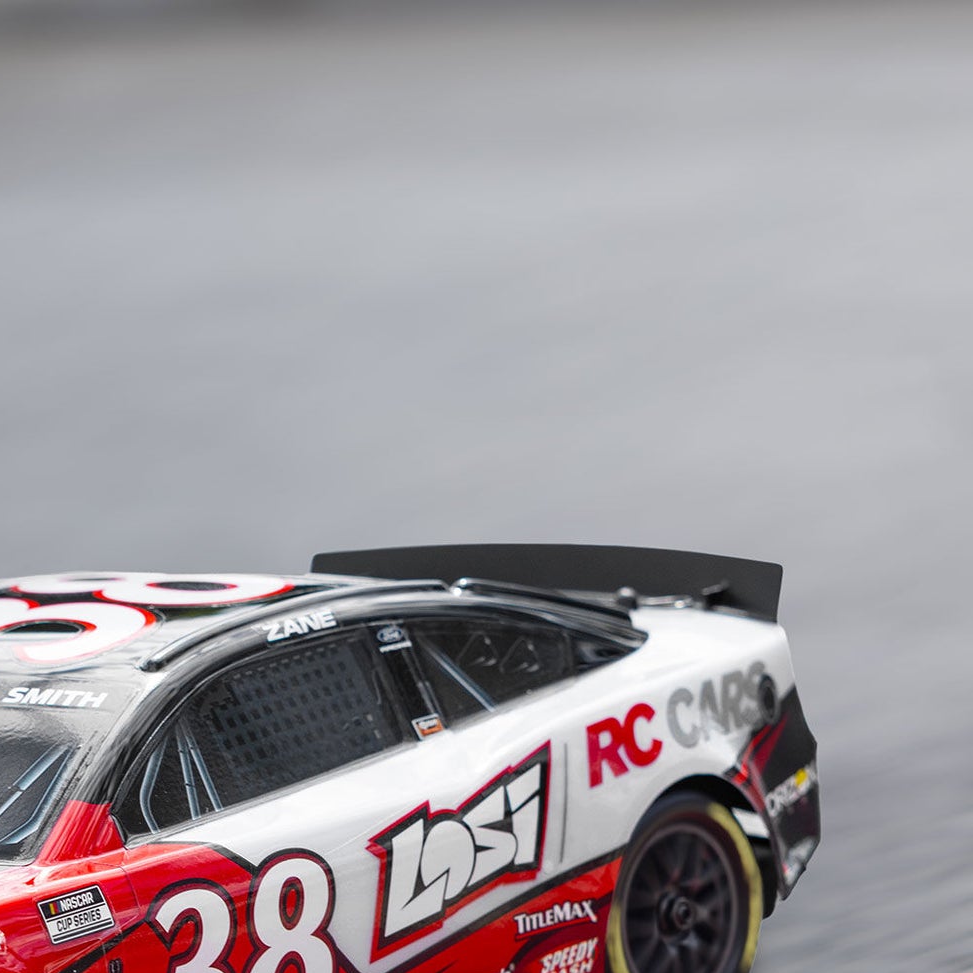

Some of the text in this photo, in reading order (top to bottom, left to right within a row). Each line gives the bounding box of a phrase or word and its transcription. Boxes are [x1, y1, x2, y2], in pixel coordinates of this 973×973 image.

[263, 611, 337, 642] ZANE
[1, 686, 108, 709] SMITH
[586, 702, 663, 789] RC
[60, 891, 94, 913] NASCAR
[56, 908, 102, 932] CUP SERIES
